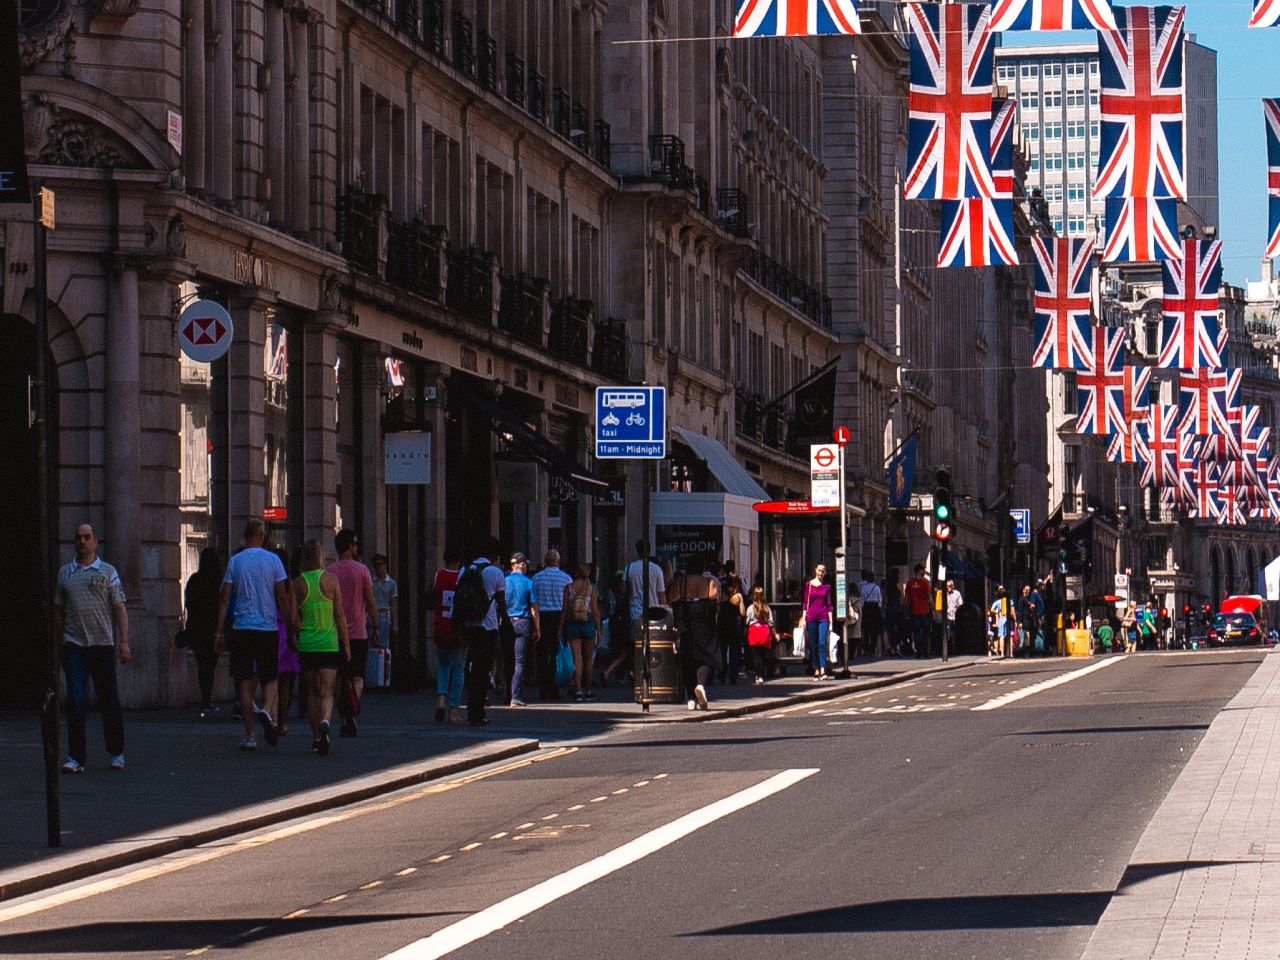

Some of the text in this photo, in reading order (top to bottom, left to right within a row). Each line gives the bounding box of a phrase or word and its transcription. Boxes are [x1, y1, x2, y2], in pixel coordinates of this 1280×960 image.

[602, 428, 618, 437] taxi
[838, 429, 847, 442] L
[600, 444, 620, 453] 11am
[626, 444, 661, 455] Midnight
